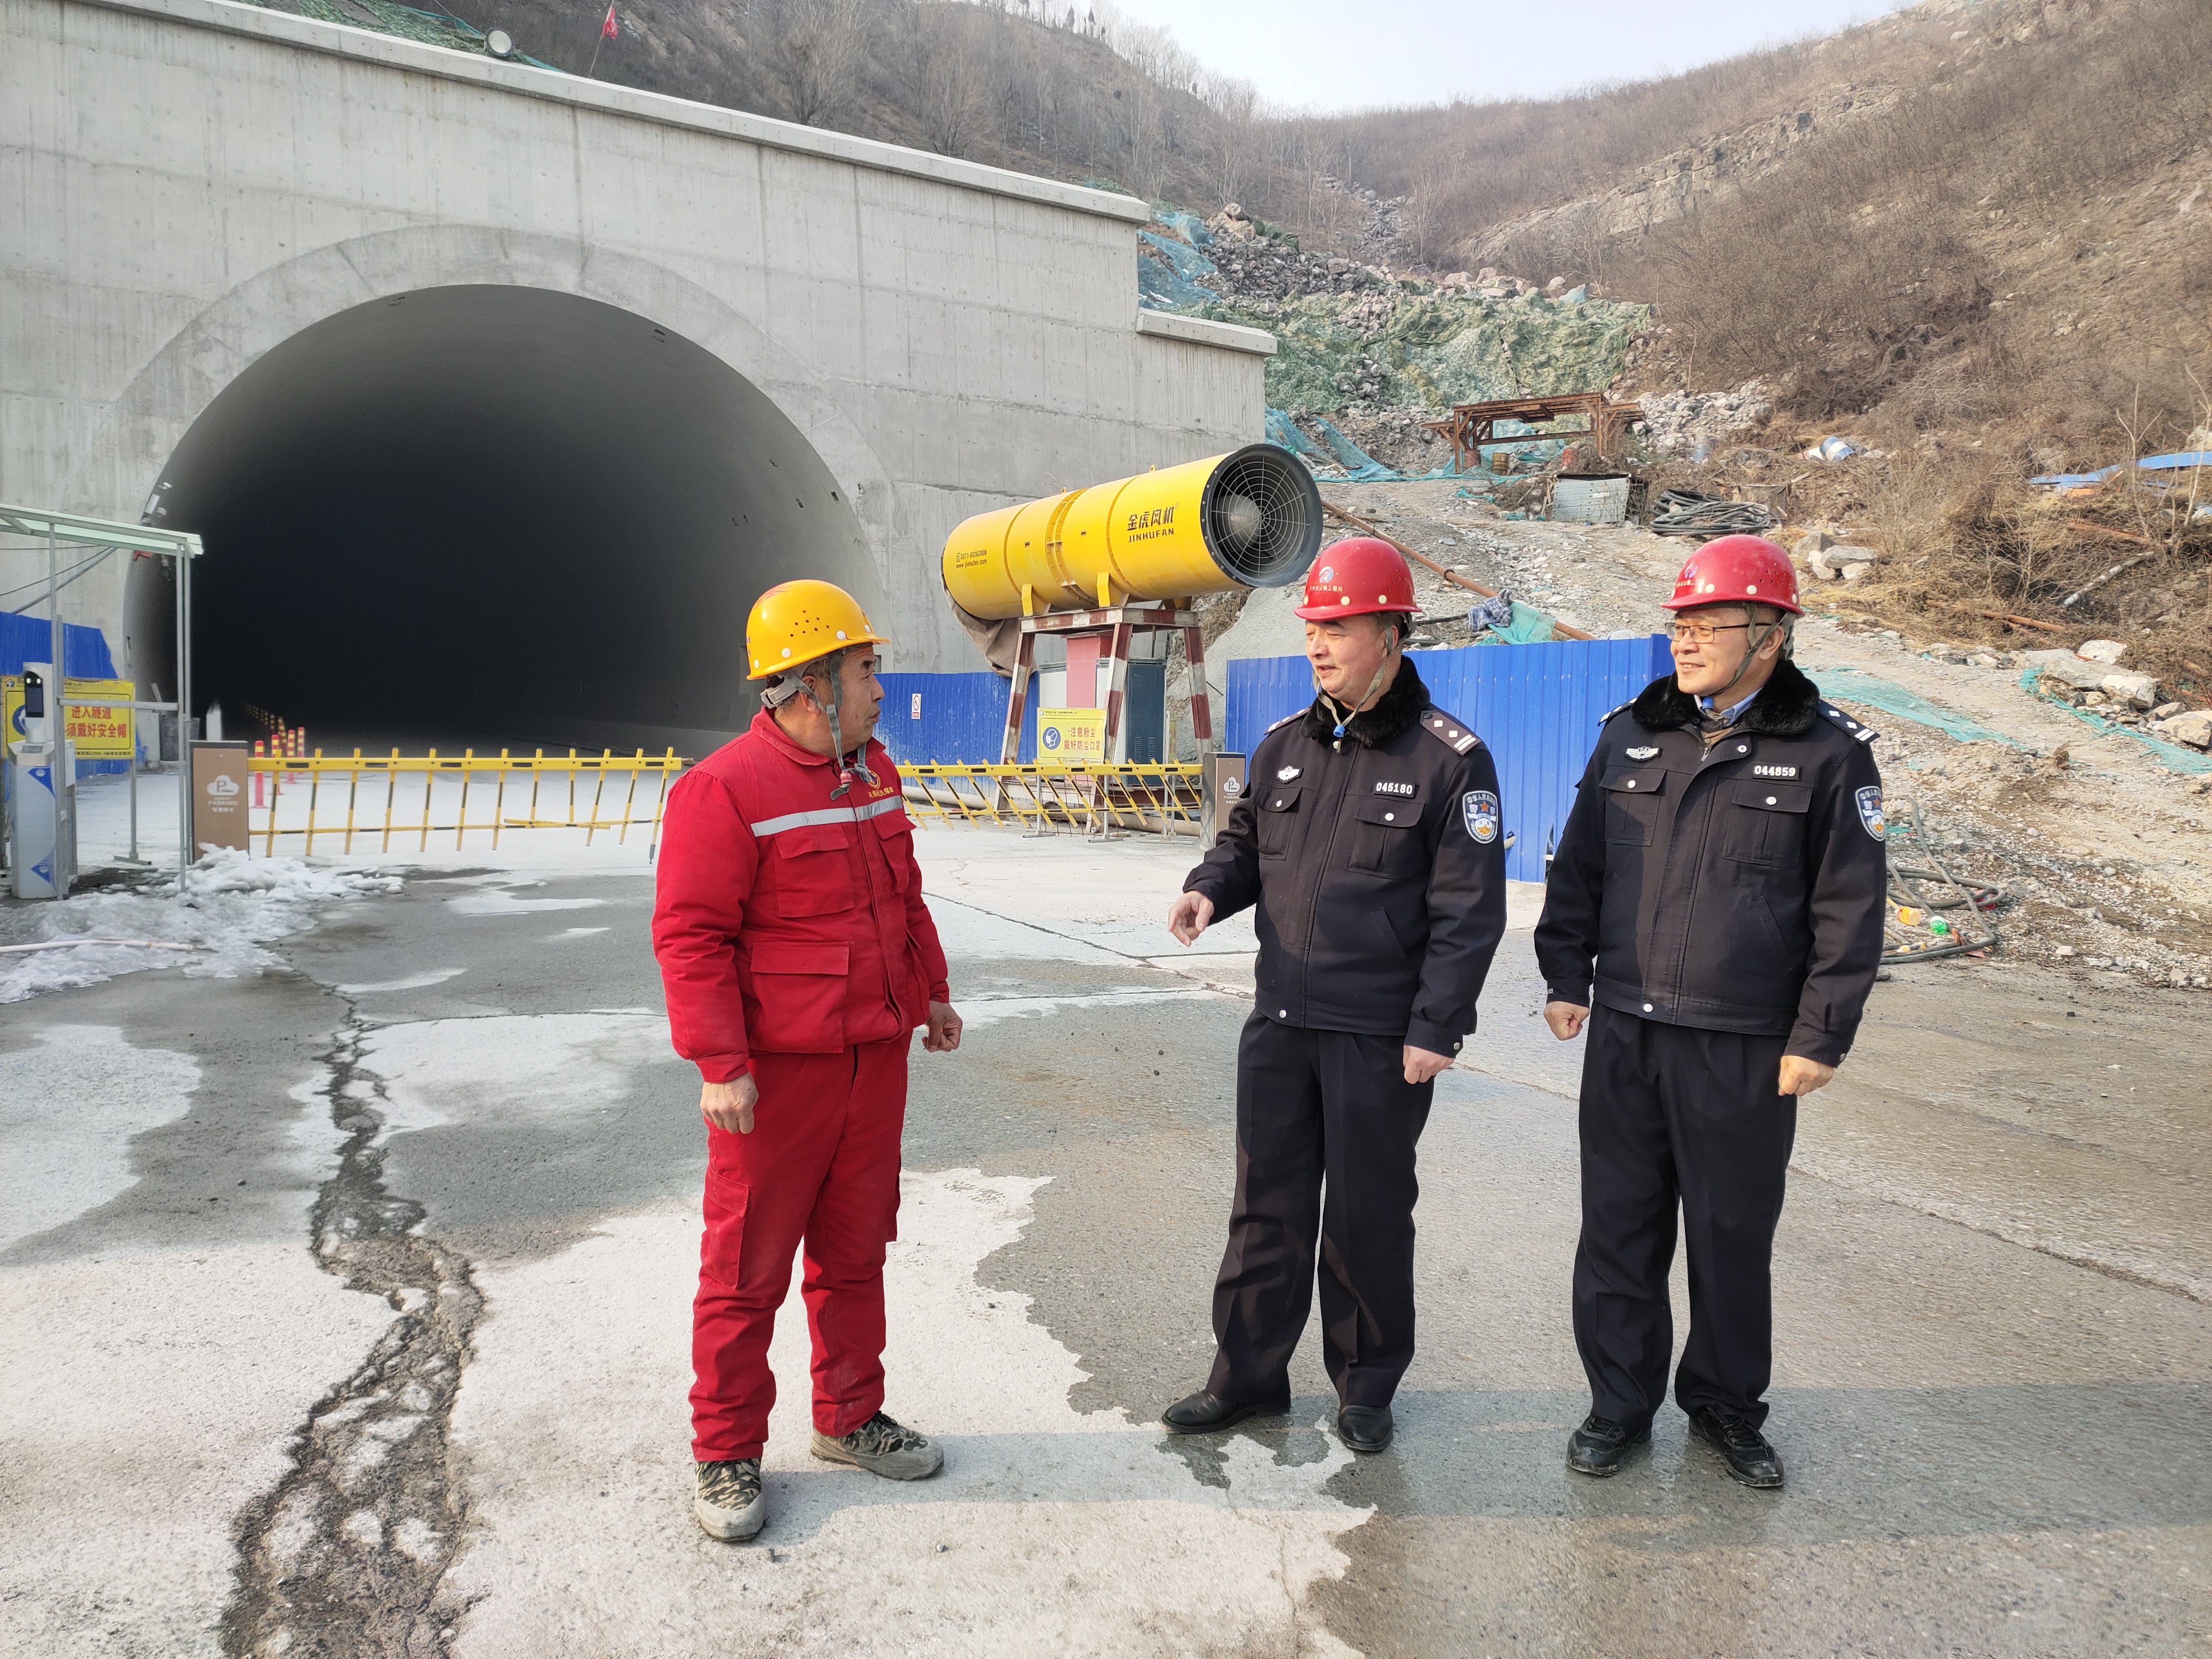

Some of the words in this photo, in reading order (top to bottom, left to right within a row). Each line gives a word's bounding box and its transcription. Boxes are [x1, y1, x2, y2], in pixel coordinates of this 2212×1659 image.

[1127, 506, 1174, 531] 金虎风机
[1128, 528, 1174, 542] JINHUFAN
[71, 706, 112, 719] 进入隧道
[66, 723, 127, 738] 须戴好安全帽
[1071, 726, 1096, 737] 注意粉尘
[1064, 740, 1100, 751] 戴好防尘口罩
[1754, 765, 1796, 776] 044859
[1376, 782, 1413, 795] 045180
